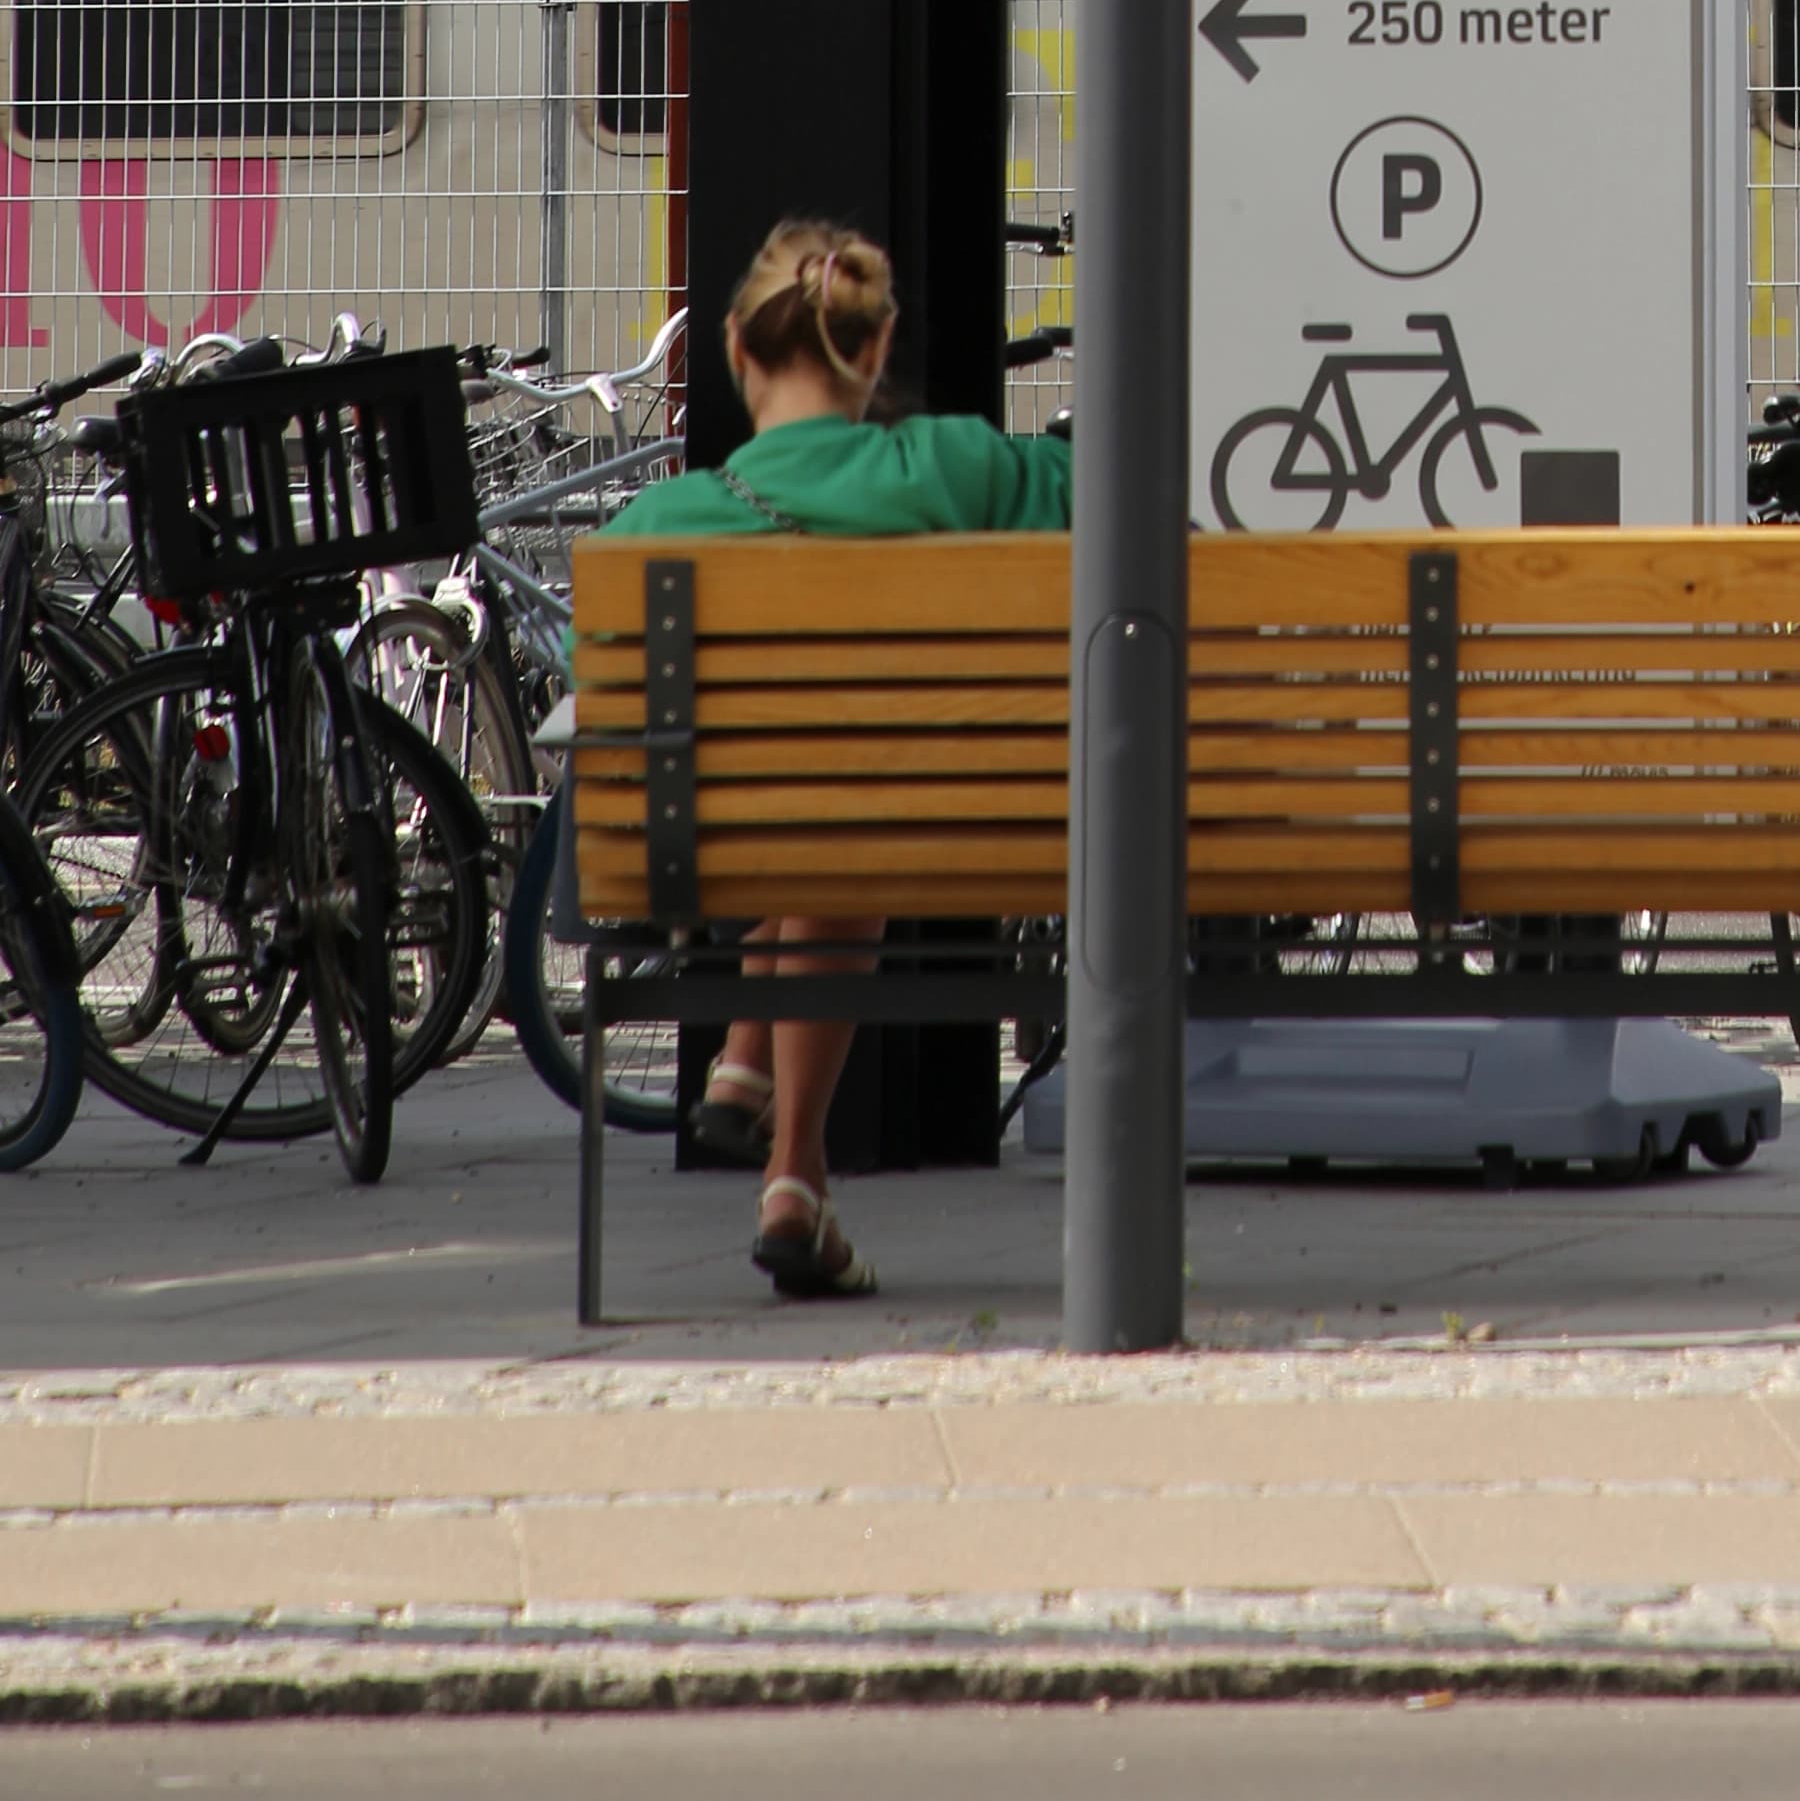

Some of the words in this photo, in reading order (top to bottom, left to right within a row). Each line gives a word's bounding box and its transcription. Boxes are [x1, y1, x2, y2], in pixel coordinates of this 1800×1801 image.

[1346, 0, 1444, 45] 250
[1459, 0, 1612, 44] meter
[1382, 152, 1443, 240] P
